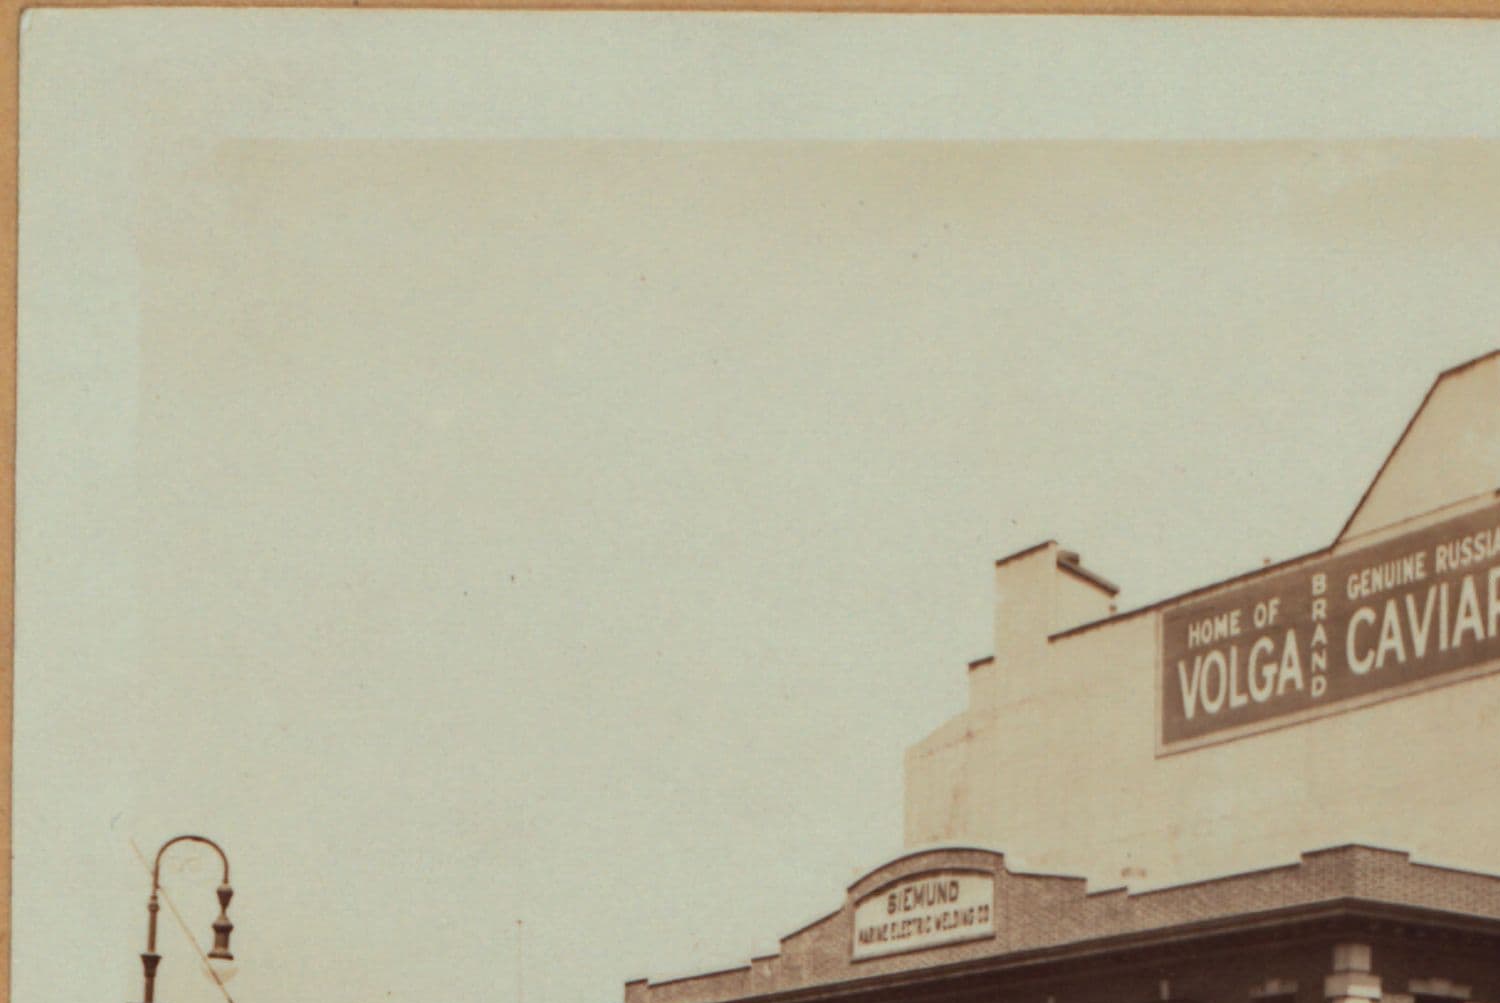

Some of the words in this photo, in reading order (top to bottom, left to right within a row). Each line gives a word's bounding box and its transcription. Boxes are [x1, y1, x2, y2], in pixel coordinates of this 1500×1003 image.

[1346, 551, 1427, 600] GENUINE
[1188, 609, 1241, 649] HOME
[1253, 598, 1281, 629] OF
[1311, 573, 1328, 698] BRAND
[1178, 629, 1303, 721] VOLGA
[887, 881, 960, 915] SIEMUND
[859, 923, 889, 944] MARINE
[891, 916, 931, 940] ELECTRIC
[935, 907, 974, 931] WELDING
